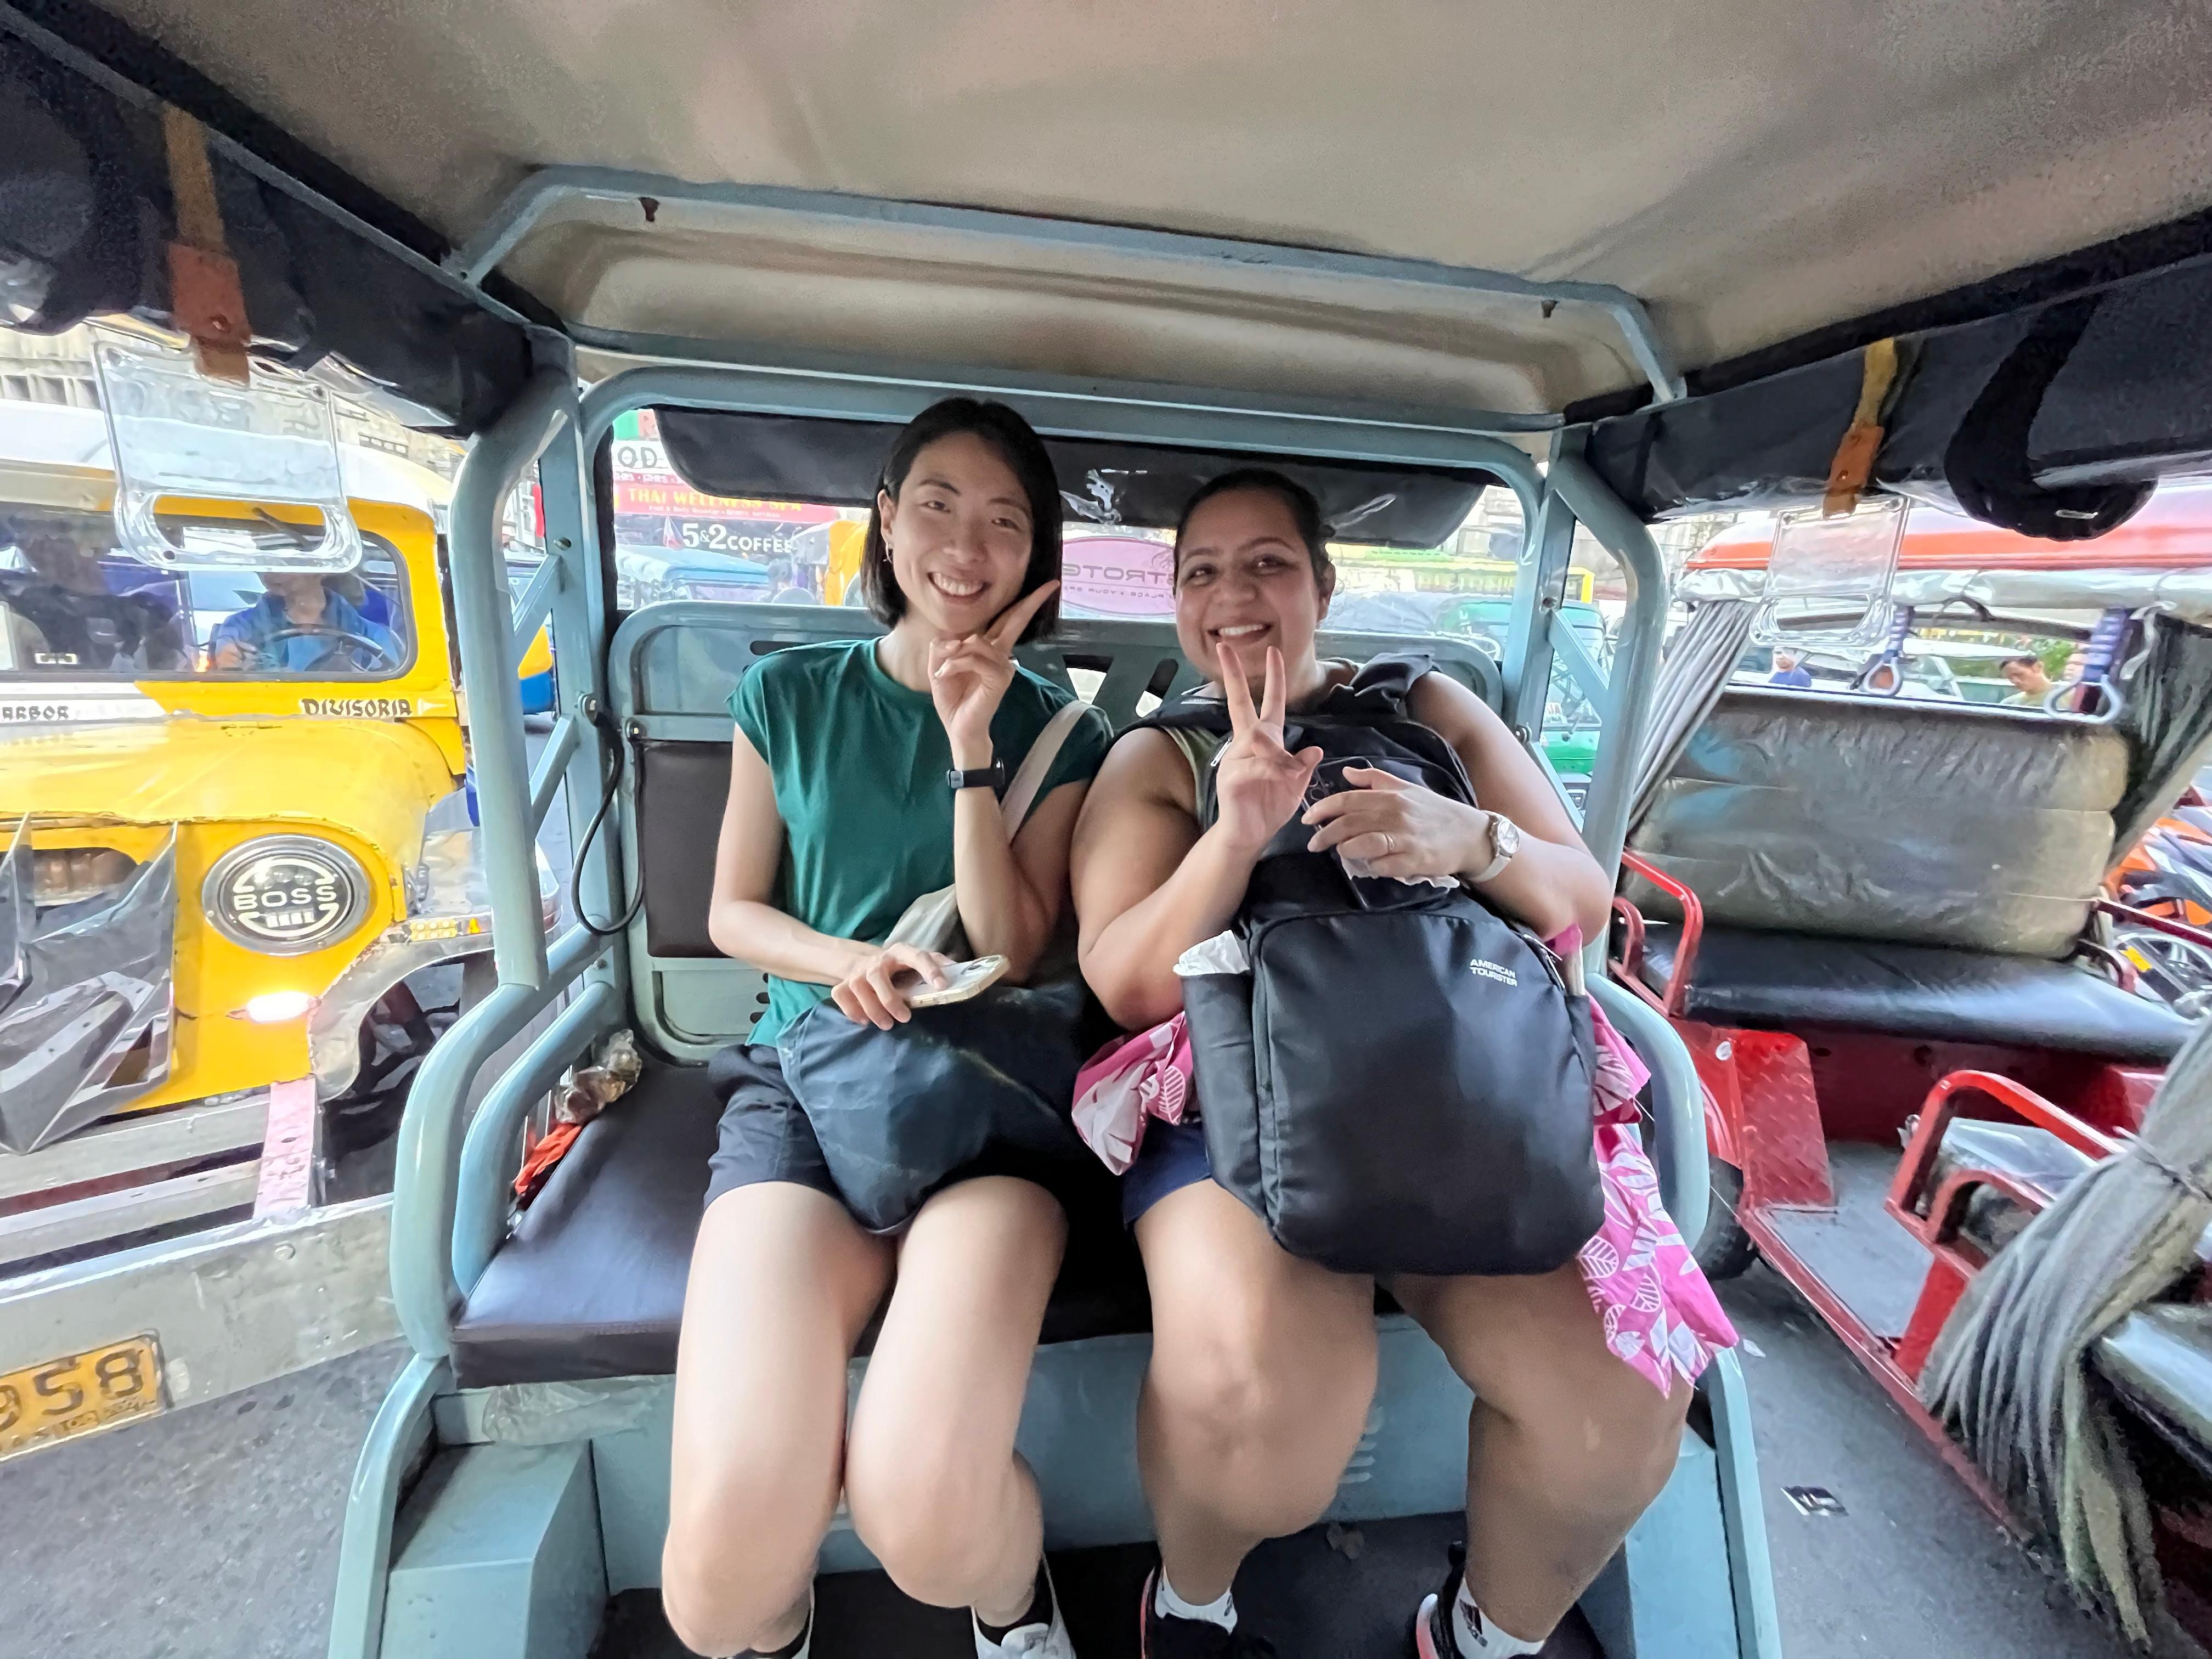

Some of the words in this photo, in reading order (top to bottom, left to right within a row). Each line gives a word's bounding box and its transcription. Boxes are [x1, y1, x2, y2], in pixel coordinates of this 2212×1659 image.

[628, 488, 667, 504] THAI
[727, 535, 793, 554] COFFEE
[301, 698, 413, 717] DIVISORIA
[233, 885, 337, 911] BOSS
[1470, 959, 1516, 979] AMERICAN
[1470, 967, 1517, 987] TOURISTER
